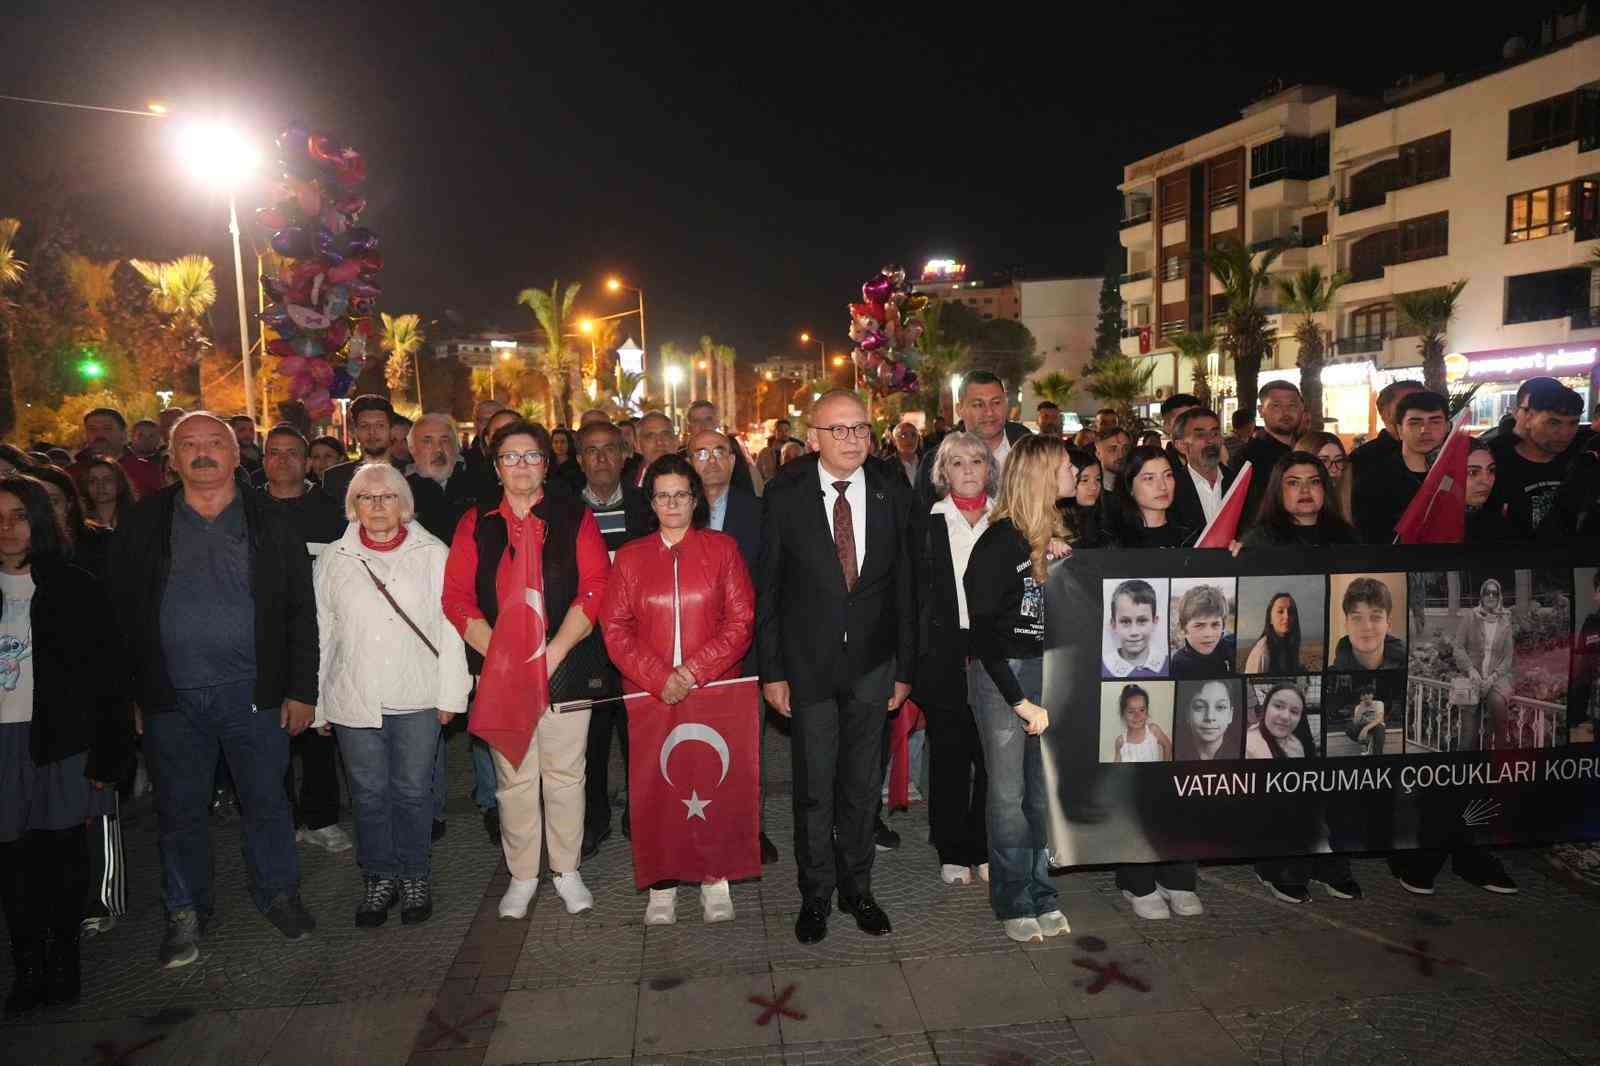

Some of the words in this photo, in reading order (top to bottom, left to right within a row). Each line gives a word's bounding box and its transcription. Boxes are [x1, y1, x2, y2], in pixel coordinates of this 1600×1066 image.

[1173, 772, 1256, 797] VATANI
[1265, 767, 1393, 793] KORUMAK
[1400, 760, 1537, 794] ÇOCUKLARI
